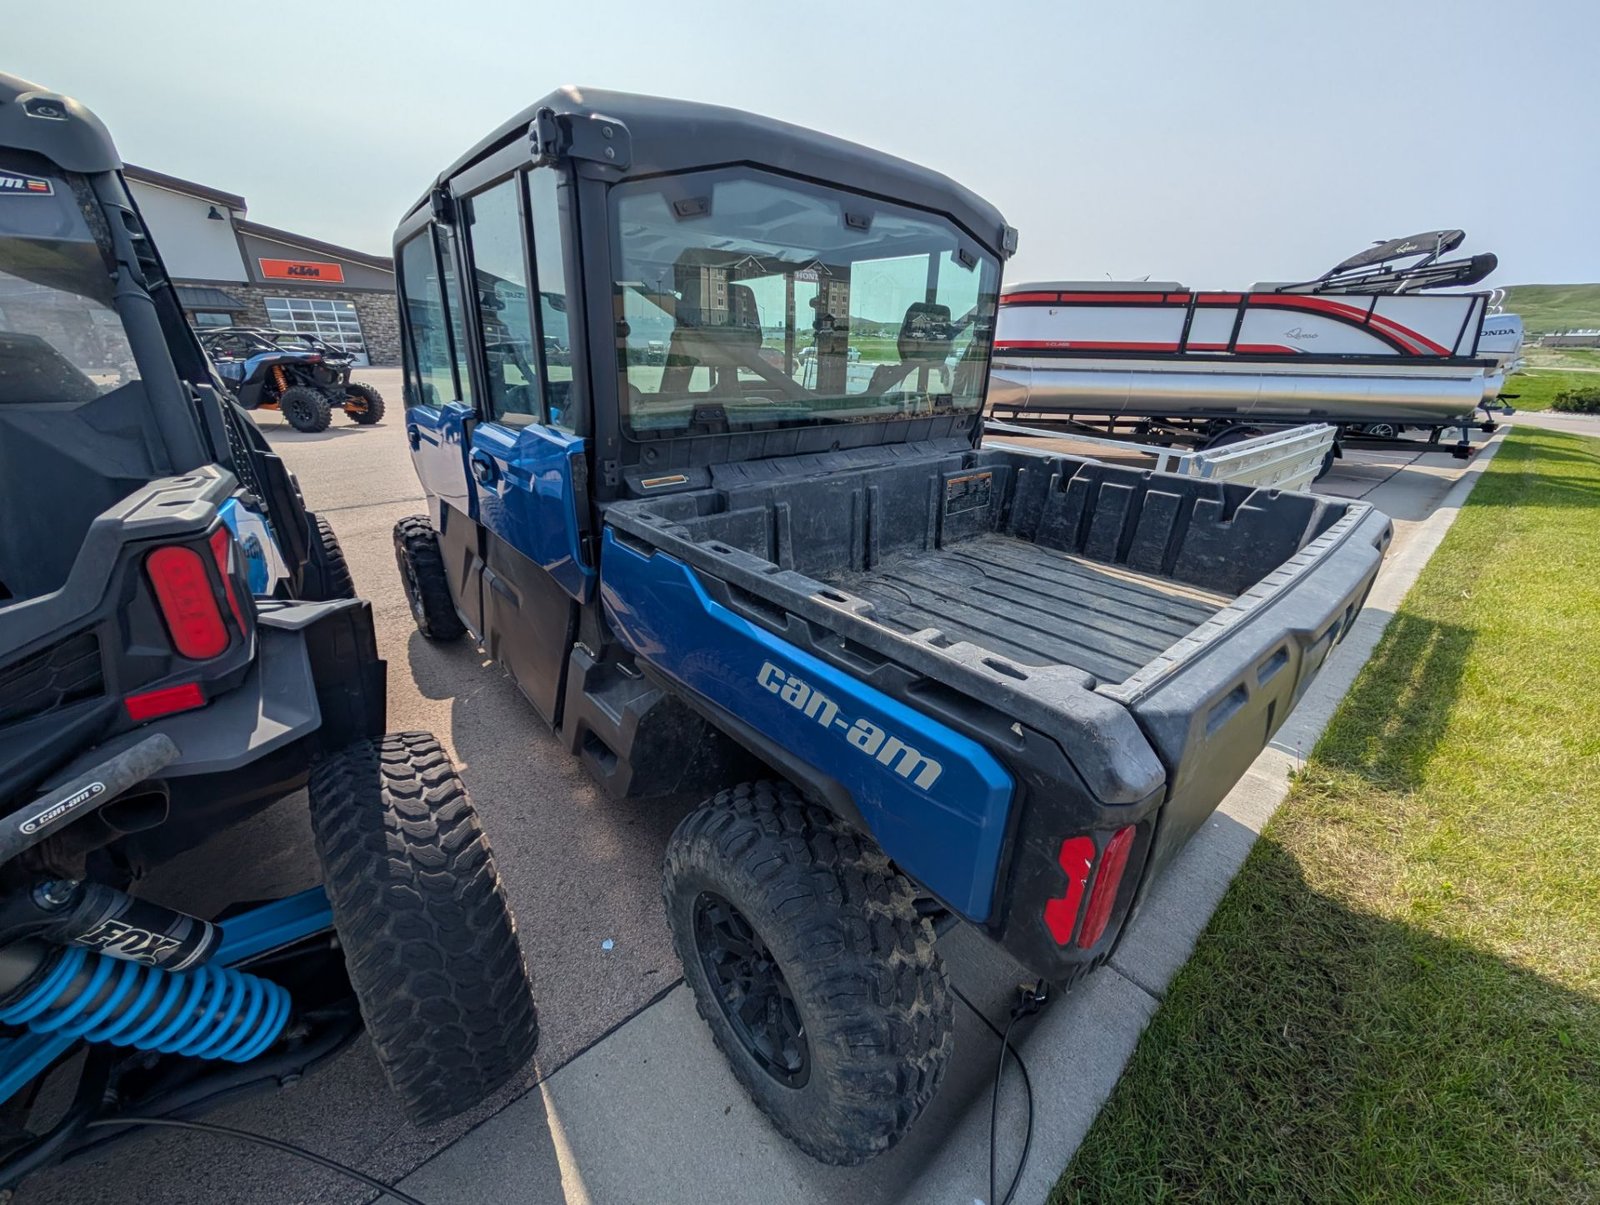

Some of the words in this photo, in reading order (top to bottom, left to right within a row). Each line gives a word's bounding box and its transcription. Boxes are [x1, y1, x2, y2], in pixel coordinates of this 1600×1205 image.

[287, 264, 320, 276] KTM
[757, 661, 942, 790] can-am
[39, 791, 90, 824] can-am
[75, 919, 182, 965] FOX
